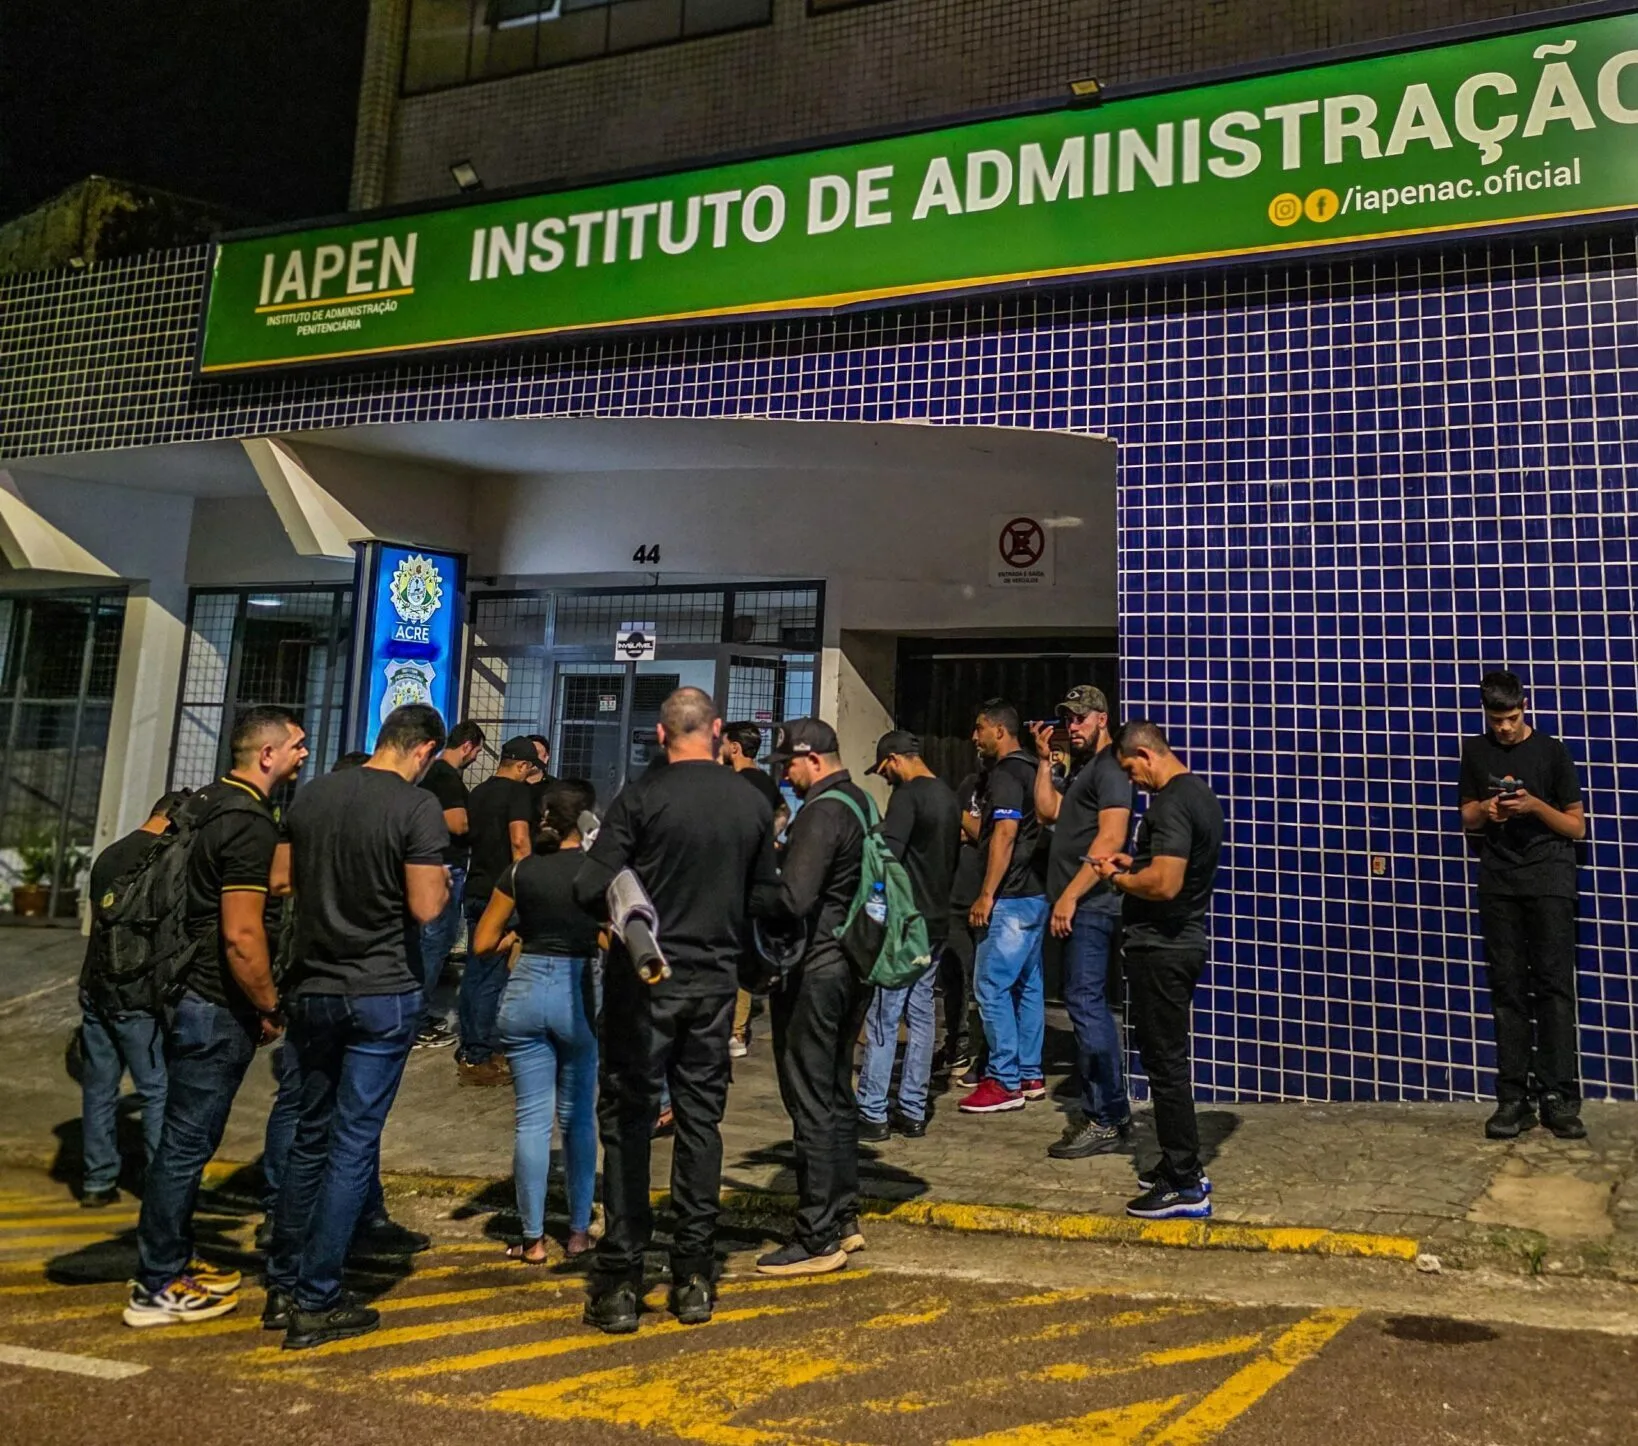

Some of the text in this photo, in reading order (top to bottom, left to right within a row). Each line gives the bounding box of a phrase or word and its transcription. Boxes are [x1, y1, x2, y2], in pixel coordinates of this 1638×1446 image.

[469, 40, 1638, 281] INSTITUTO DE ADMINISTRAÇÃO
[1340, 157, 1582, 215] /iapenac.oficial
[258, 232, 418, 306] IAPEN
[266, 299, 398, 326] INSTITUTO DE ADMINISTRAÇÃO
[296, 319, 362, 336] PENITENCIÁRIA
[632, 544, 661, 564] 44
[395, 625, 430, 641] ACRE
